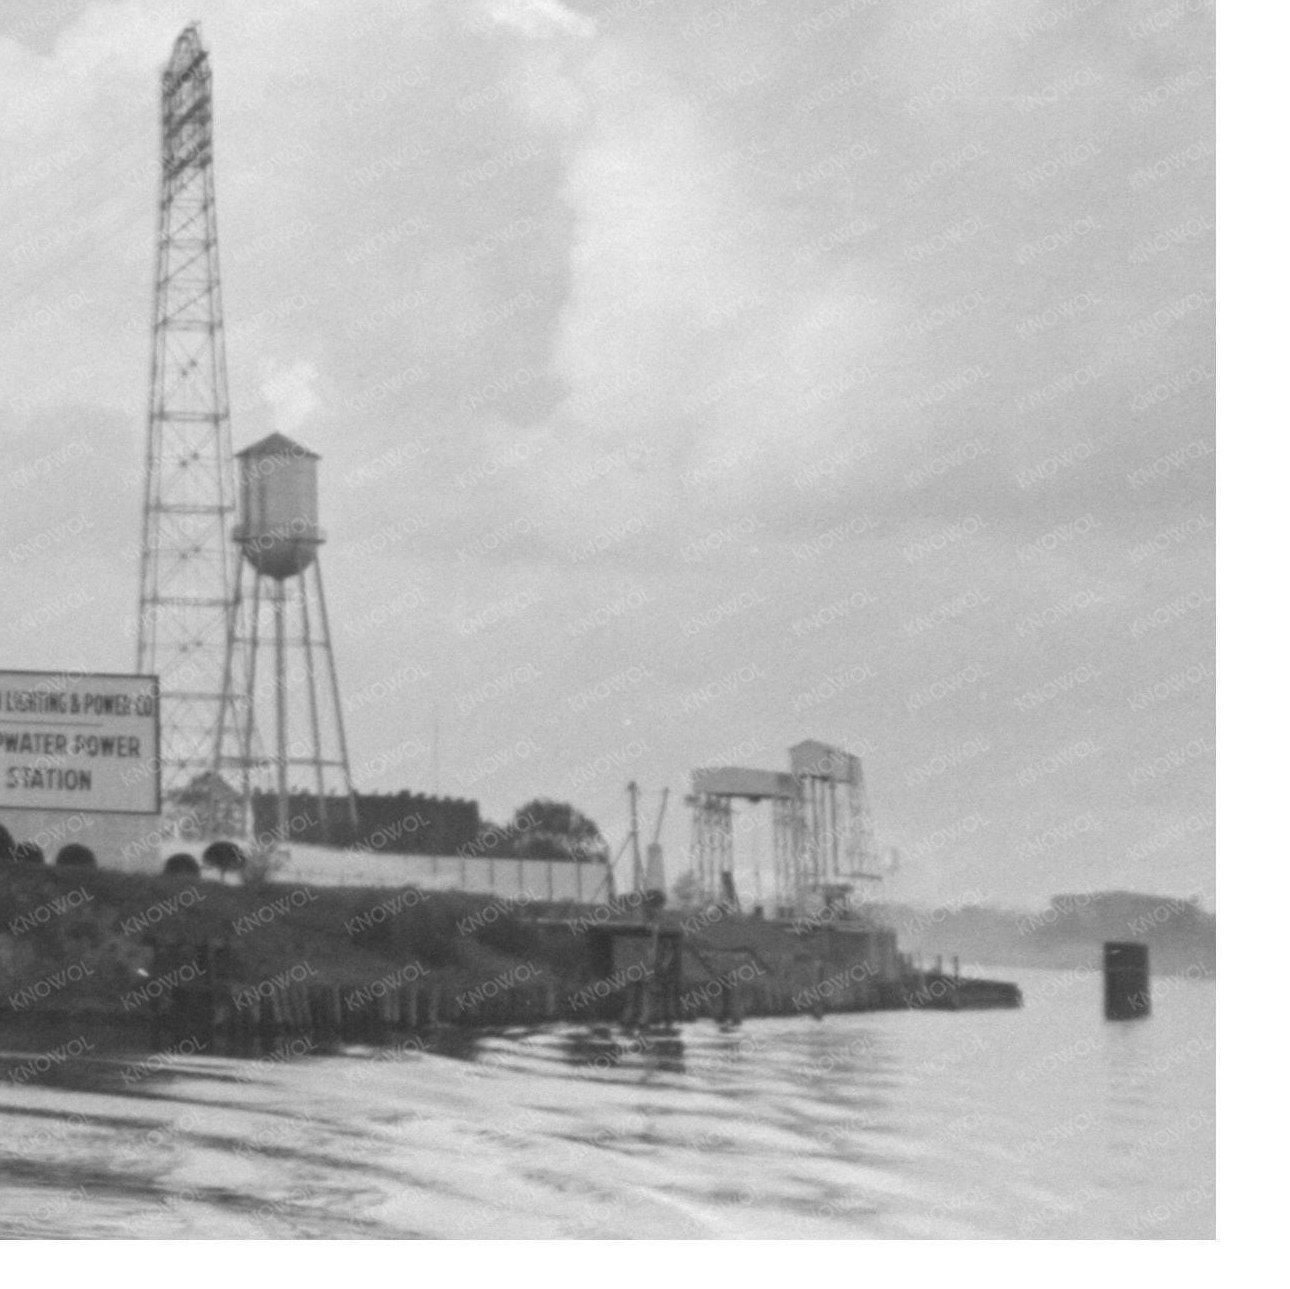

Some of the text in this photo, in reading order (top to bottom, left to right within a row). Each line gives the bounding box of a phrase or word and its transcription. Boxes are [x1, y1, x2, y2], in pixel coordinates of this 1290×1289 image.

[6, 691, 67, 714] LIGHTING
[70, 692, 81, 714] &
[84, 693, 131, 716] POWER
[75, 734, 140, 758] POWER
[6, 766, 92, 791] STATION
